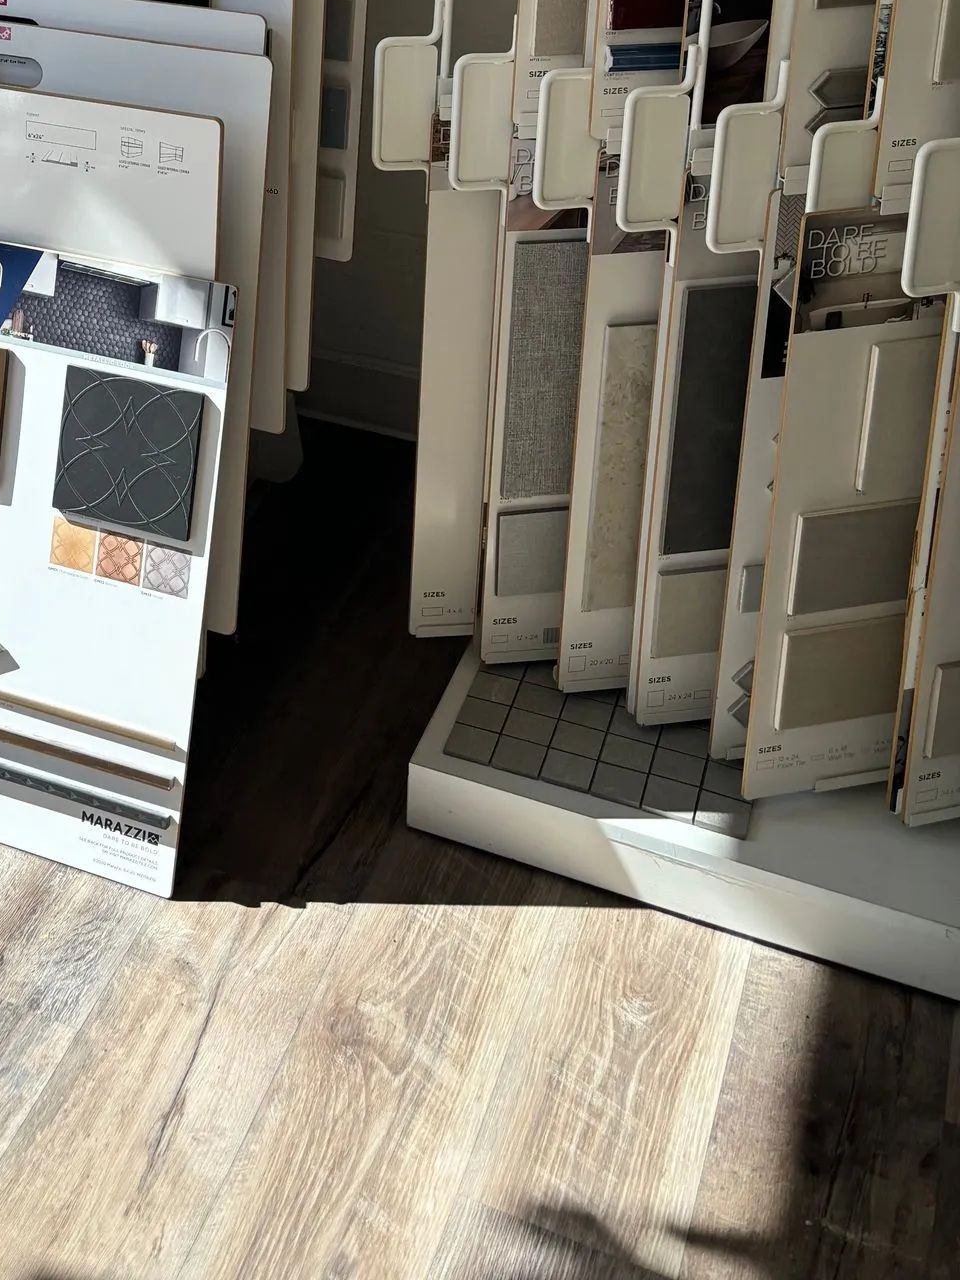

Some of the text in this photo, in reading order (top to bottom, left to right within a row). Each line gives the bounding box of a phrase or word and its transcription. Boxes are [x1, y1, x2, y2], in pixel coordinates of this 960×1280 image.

[603, 86, 629, 96] SIZES
[891, 138, 918, 149] SIZES
[808, 223, 876, 250] DARE
[820, 242, 851, 263] TO
[810, 256, 878, 280] BOLD
[422, 591, 446, 599] SIZES
[492, 617, 519, 626] SIZES
[569, 641, 594, 650] SIZES
[589, 659, 598, 667] 20
[647, 675, 672, 686] SIZES
[758, 744, 783, 755] SIZES
[918, 770, 942, 783] SIZES
[81, 810, 147, 842] MARAZZI
[121, 838, 130, 847] TO
